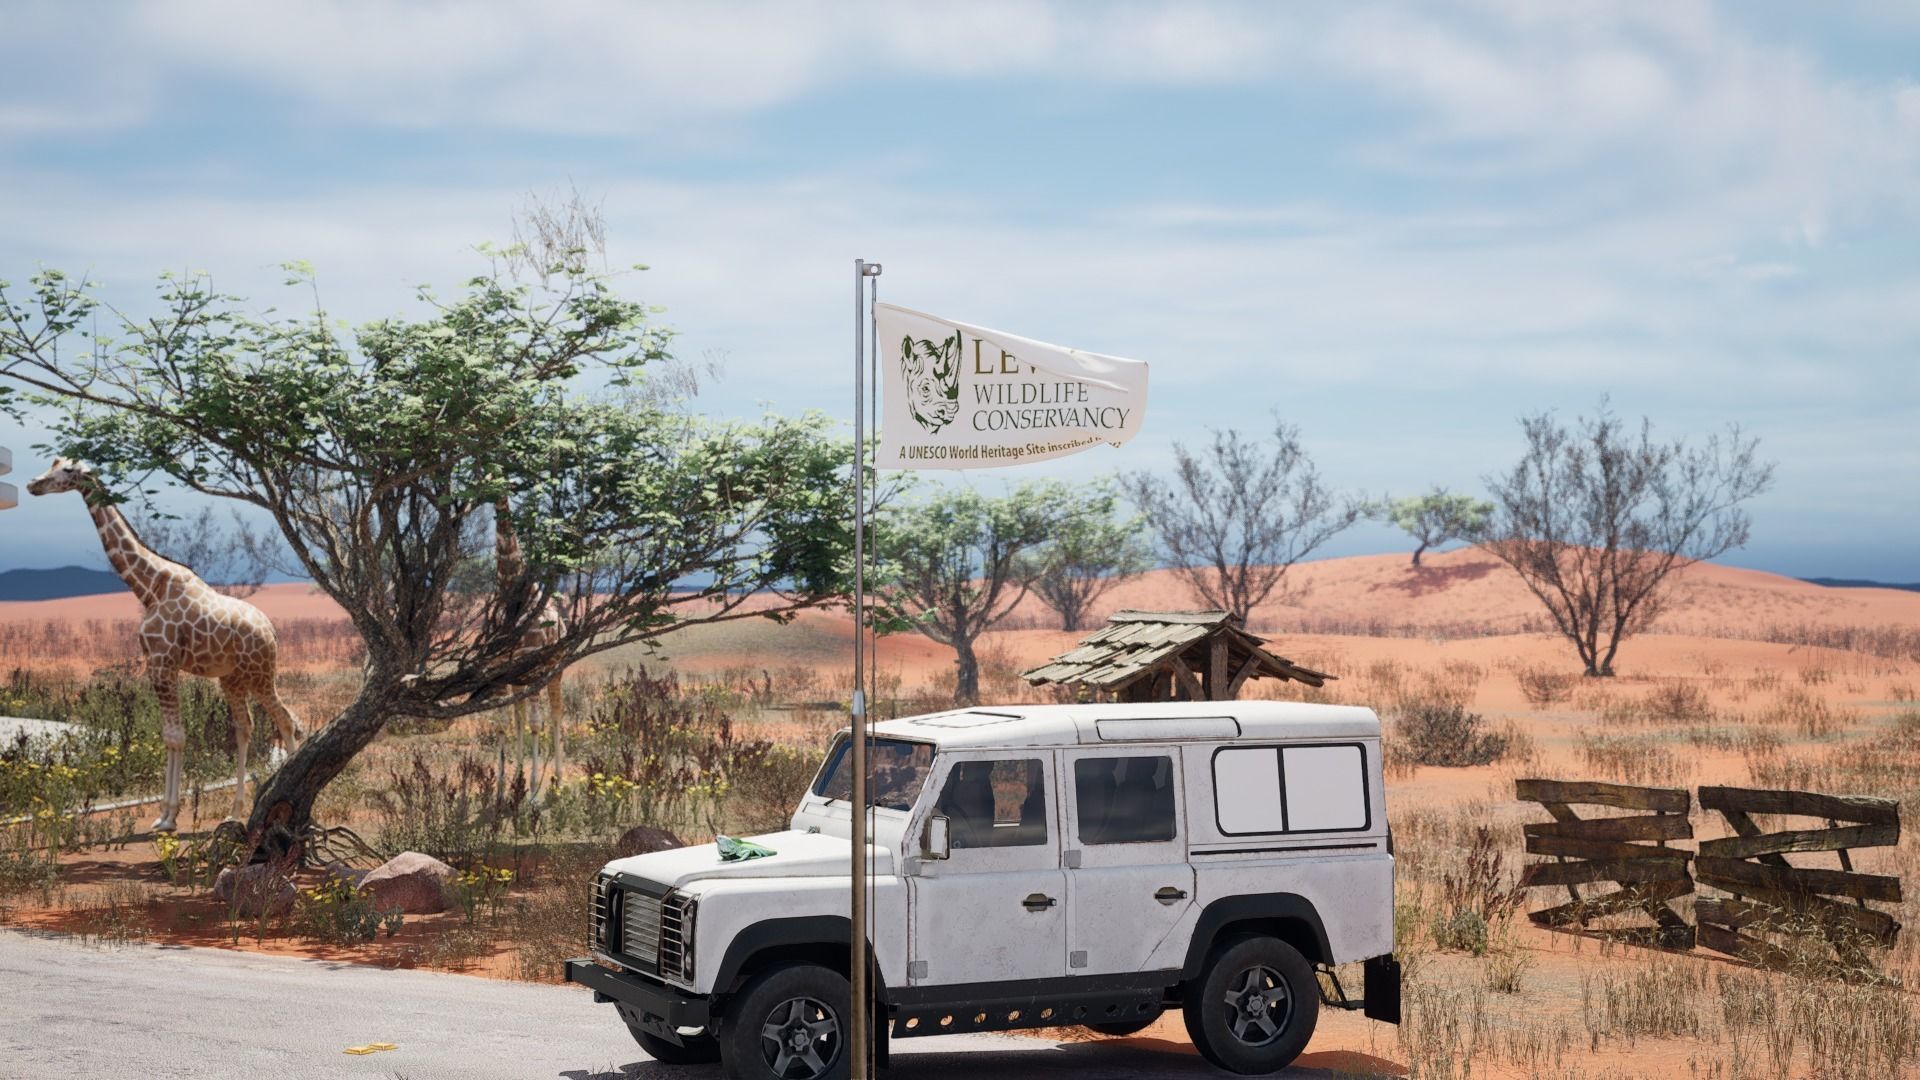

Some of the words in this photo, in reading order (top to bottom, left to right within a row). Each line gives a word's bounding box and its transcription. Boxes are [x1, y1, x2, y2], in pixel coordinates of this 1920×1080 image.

[972, 339, 1037, 374] LE
[973, 382, 1089, 405] WILDLIFE
[972, 407, 1131, 431] CONSERVANCY
[899, 446, 906, 459] A
[908, 445, 947, 460] UNESCO
[949, 445, 979, 460] World
[981, 444, 1024, 460] Heritage
[1026, 443, 1046, 456] Site
[1047, 436, 1093, 452] inscribed
